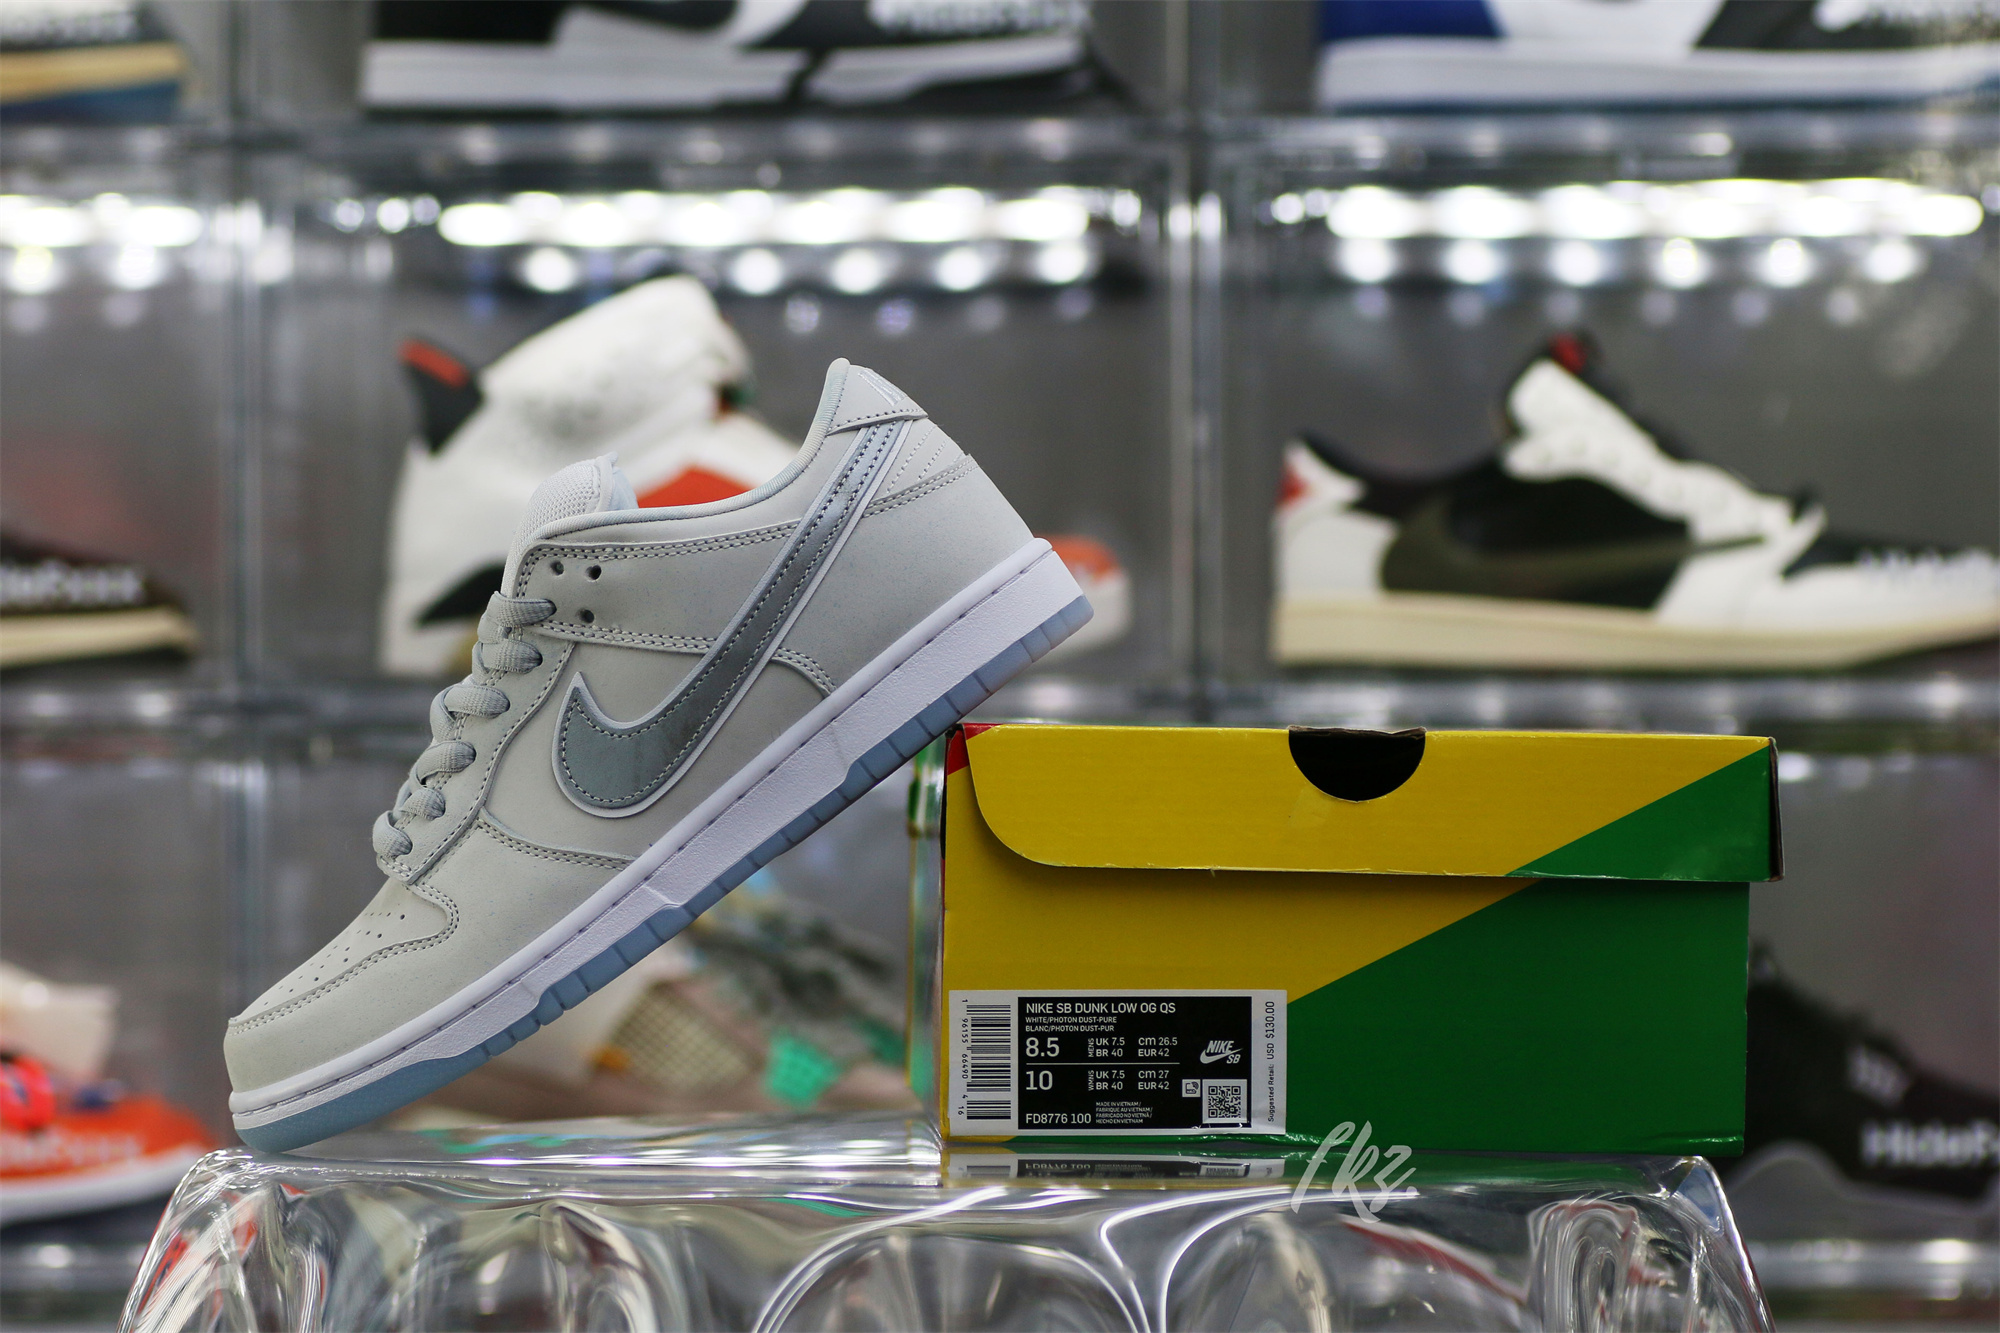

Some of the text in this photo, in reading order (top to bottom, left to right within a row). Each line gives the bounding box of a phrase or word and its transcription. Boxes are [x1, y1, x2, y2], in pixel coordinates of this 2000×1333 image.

[1026, 1002, 1176, 1014] NIKE SB DUNK LOW OG QS
[1025, 1016, 1117, 1024] WHITE/PHOTON DUST-PURE
[1265, 1001, 1275, 1039] $130.00
[1025, 1025, 1115, 1033] BLANC/PHOTON DUST-PUR
[1096, 1037, 1125, 1046] UK 7.5
[1158, 1037, 1178, 1046] 26.5
[1025, 1036, 1060, 1058] 8.5
[1206, 1040, 1234, 1054] NIKE
[1267, 1043, 1275, 1060] USD
[1096, 1048, 1123, 1057] BR 40
[1138, 1048, 1170, 1057] EUR 42
[1226, 1054, 1241, 1064] SB
[1096, 1070, 1125, 1079] UK 7.5
[1158, 1070, 1170, 1079] 27
[1025, 1070, 1053, 1091] 10
[1096, 1081, 1123, 1090] BR 40
[1138, 1081, 1170, 1090] EUR 42
[1268, 1086, 1276, 1122] Suggested
[958, 1105, 964, 1116] 16
[1025, 1113, 1091, 1124] FD8776 100
